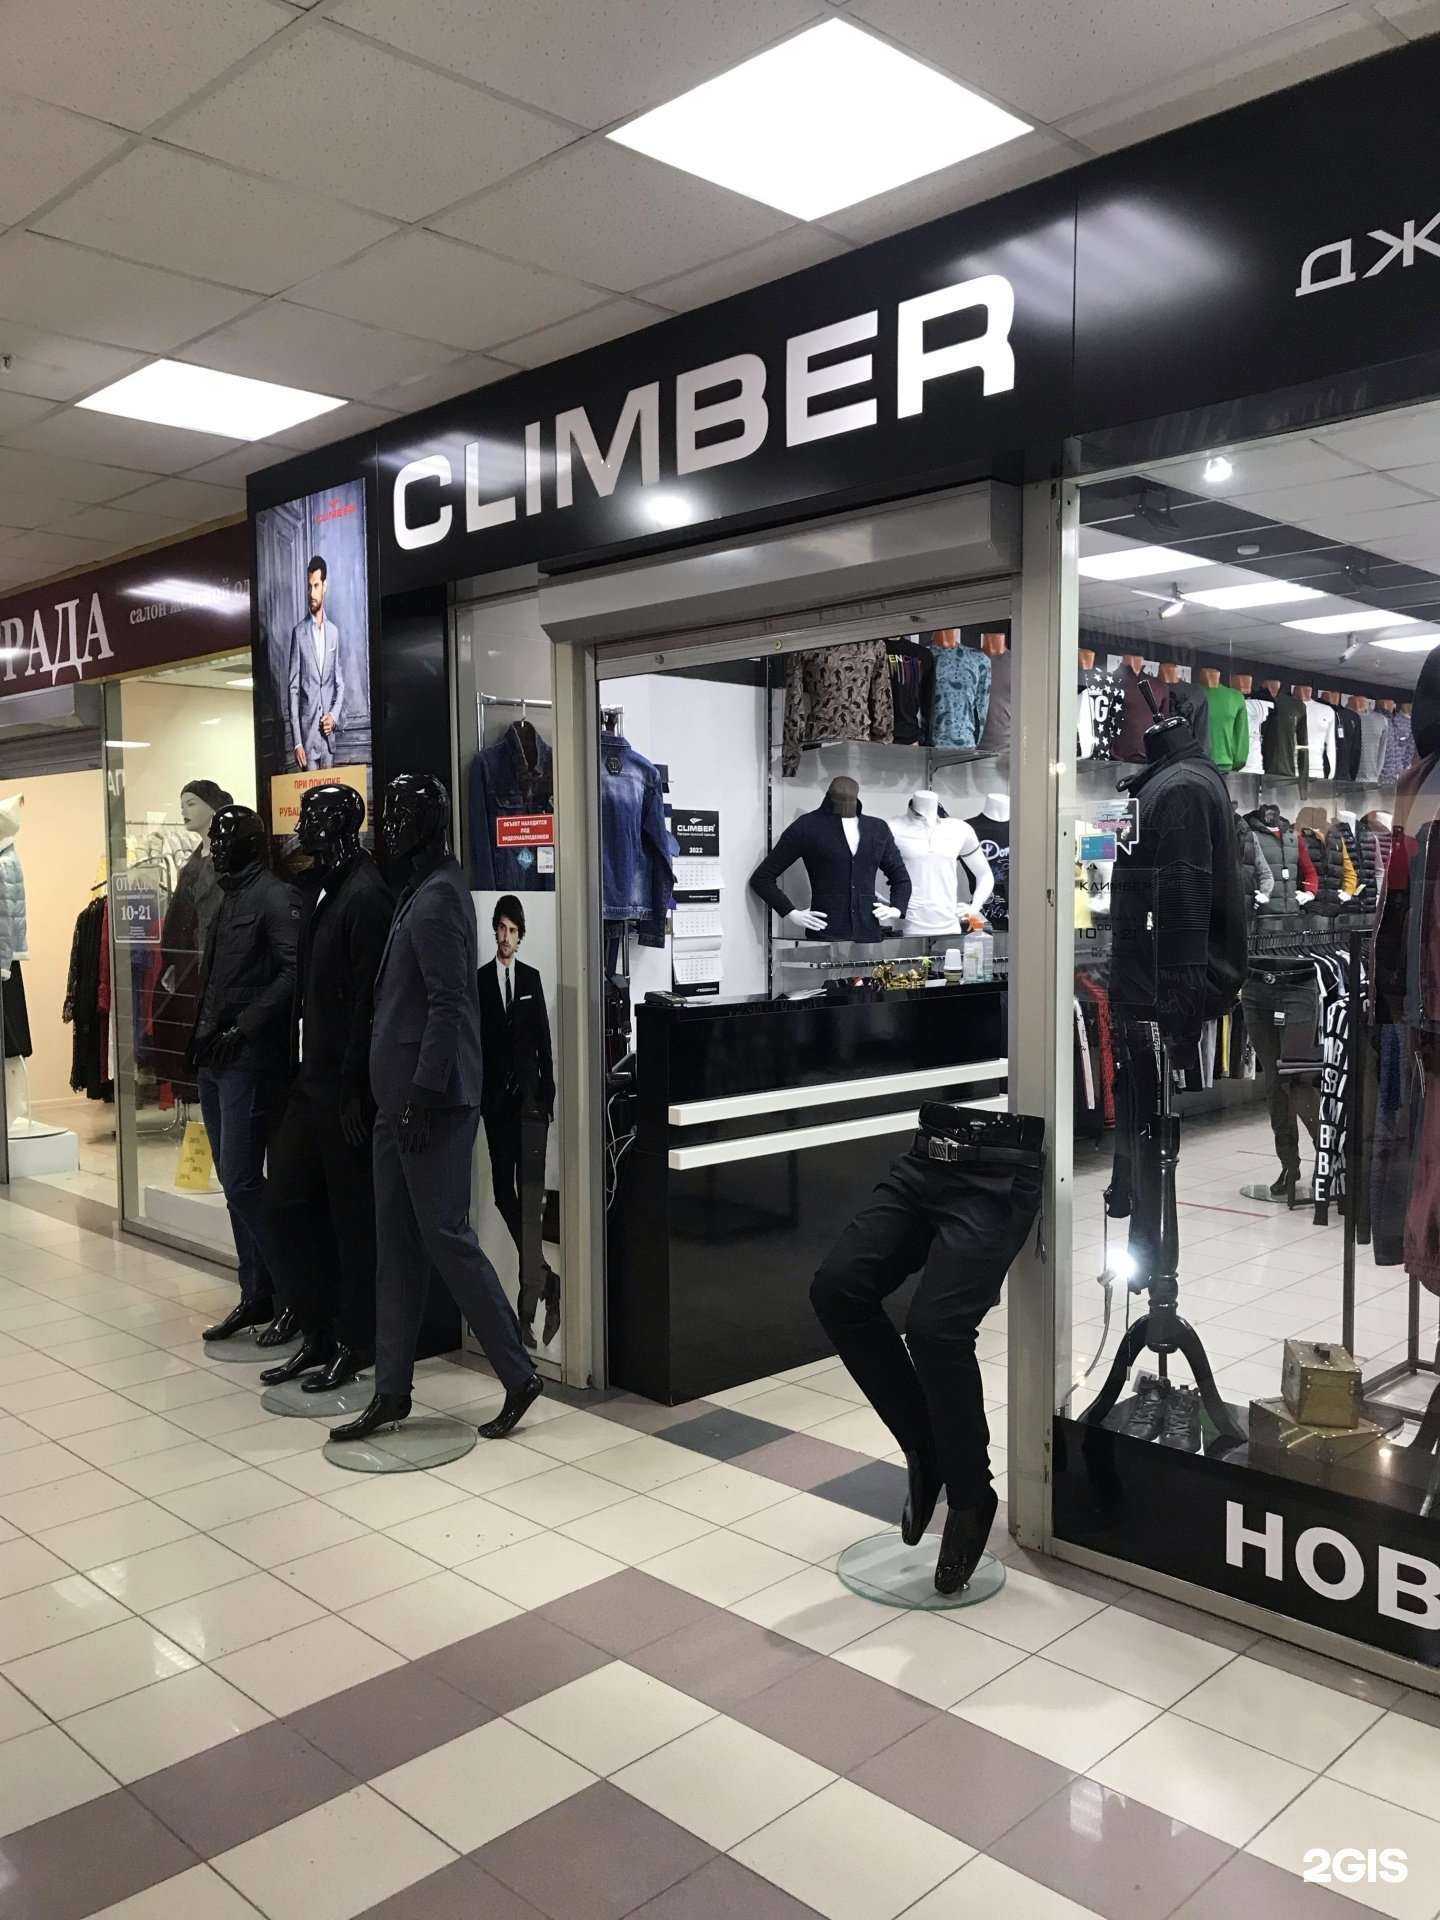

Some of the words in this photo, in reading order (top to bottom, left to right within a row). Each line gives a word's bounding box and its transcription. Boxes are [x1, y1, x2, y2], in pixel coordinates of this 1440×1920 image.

[393, 274, 1016, 551] CLIMBER
[279, 807, 300, 817] РУБА
[677, 824, 714, 832] CLIMBER
[120, 904, 152, 921] 10-21
[1225, 1499, 1440, 1630] НОВ
